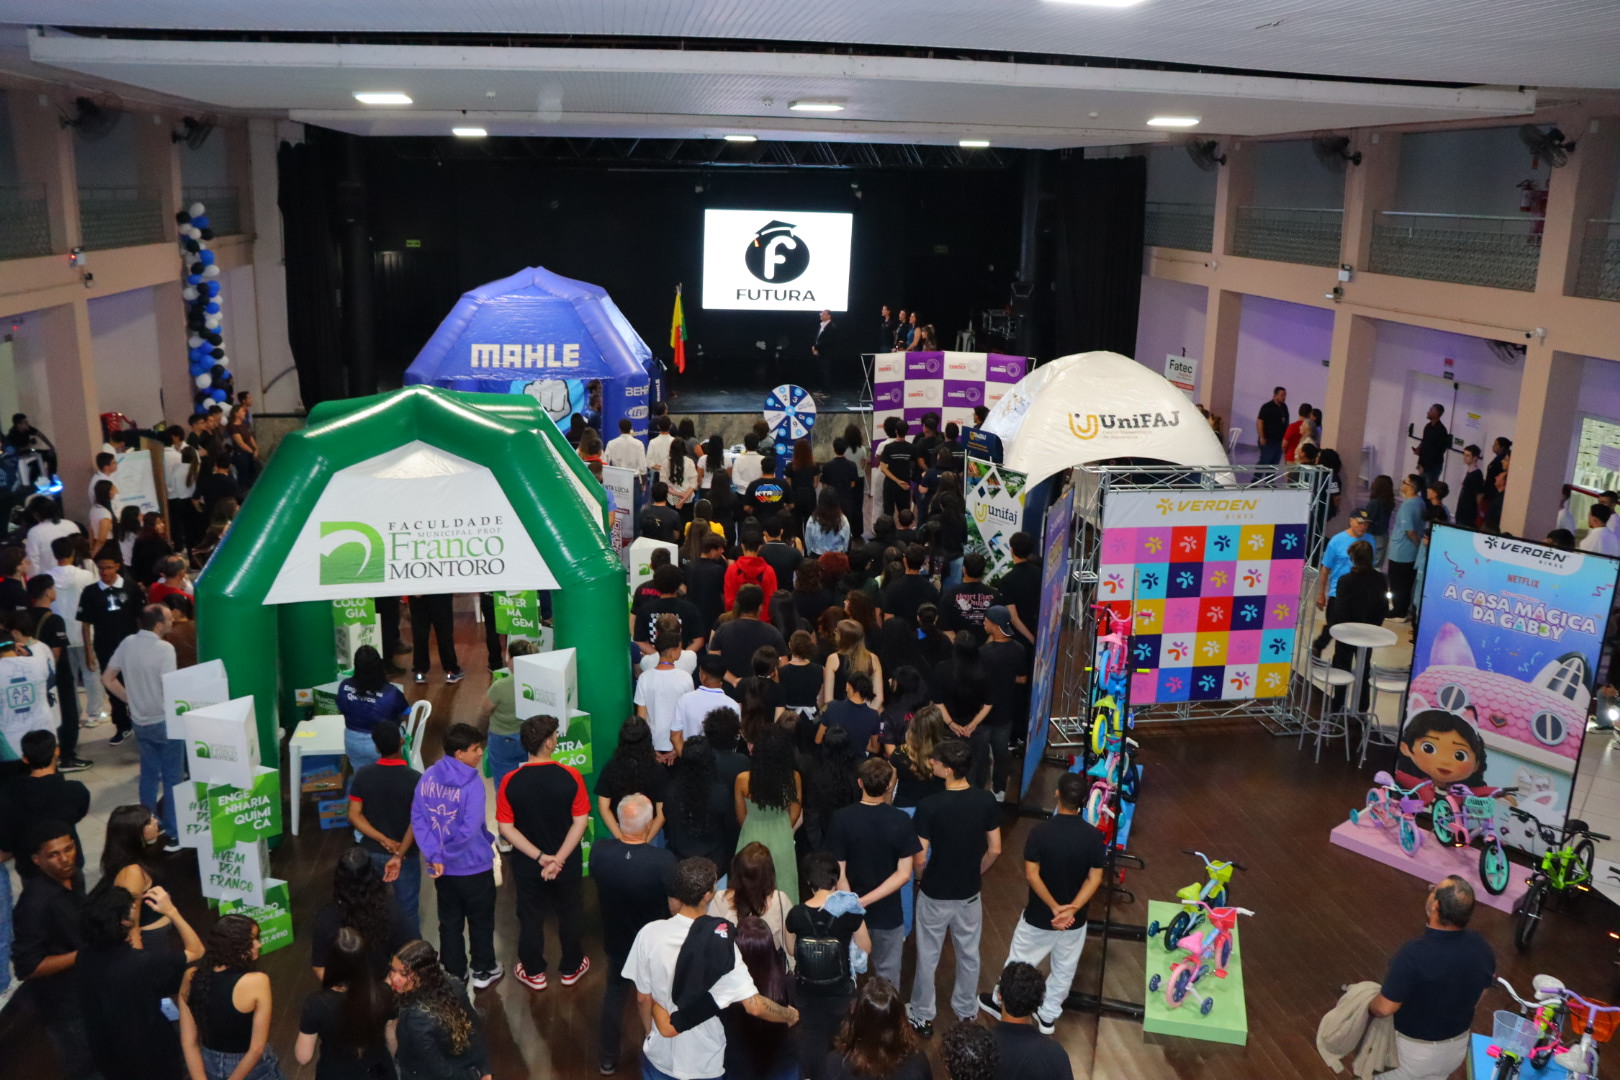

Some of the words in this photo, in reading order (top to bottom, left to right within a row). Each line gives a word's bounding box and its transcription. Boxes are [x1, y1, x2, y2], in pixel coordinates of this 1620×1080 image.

[736, 288, 816, 302] FUTURA
[471, 343, 580, 368] MAHLE
[1169, 359, 1193, 374] Fatec
[1100, 411, 1180, 429] UniFAJ
[1177, 499, 1257, 512] VERDEN
[988, 503, 1018, 525] unifaj
[388, 515, 504, 531] FACULDADE
[418, 528, 474, 538] MUNICIPAL
[388, 531, 505, 561] Franco
[1500, 541, 1568, 563] VERDEN
[388, 557, 505, 580] MONTORO
[1507, 574, 1541, 589] NETFLIX
[498, 595, 527, 608] ENFER
[1443, 583, 1459, 601] A
[1461, 587, 1512, 614] CASA
[1513, 601, 1597, 636] MÁGICA
[345, 608, 368, 618] GIA
[506, 608, 523, 617] MA
[512, 617, 534, 629] GEM
[1471, 604, 1497, 625] DA
[1499, 613, 1566, 642] GABBY
[420, 776, 461, 803] NIRVANA
[218, 790, 250, 806] ENGE
[225, 795, 271, 815] NHARIA
[234, 806, 271, 825] QUÍMI
[253, 818, 272, 830] CA
[212, 850, 246, 864] #VEM
[219, 861, 241, 878] PRA
[209, 874, 253, 893] FRANCO
